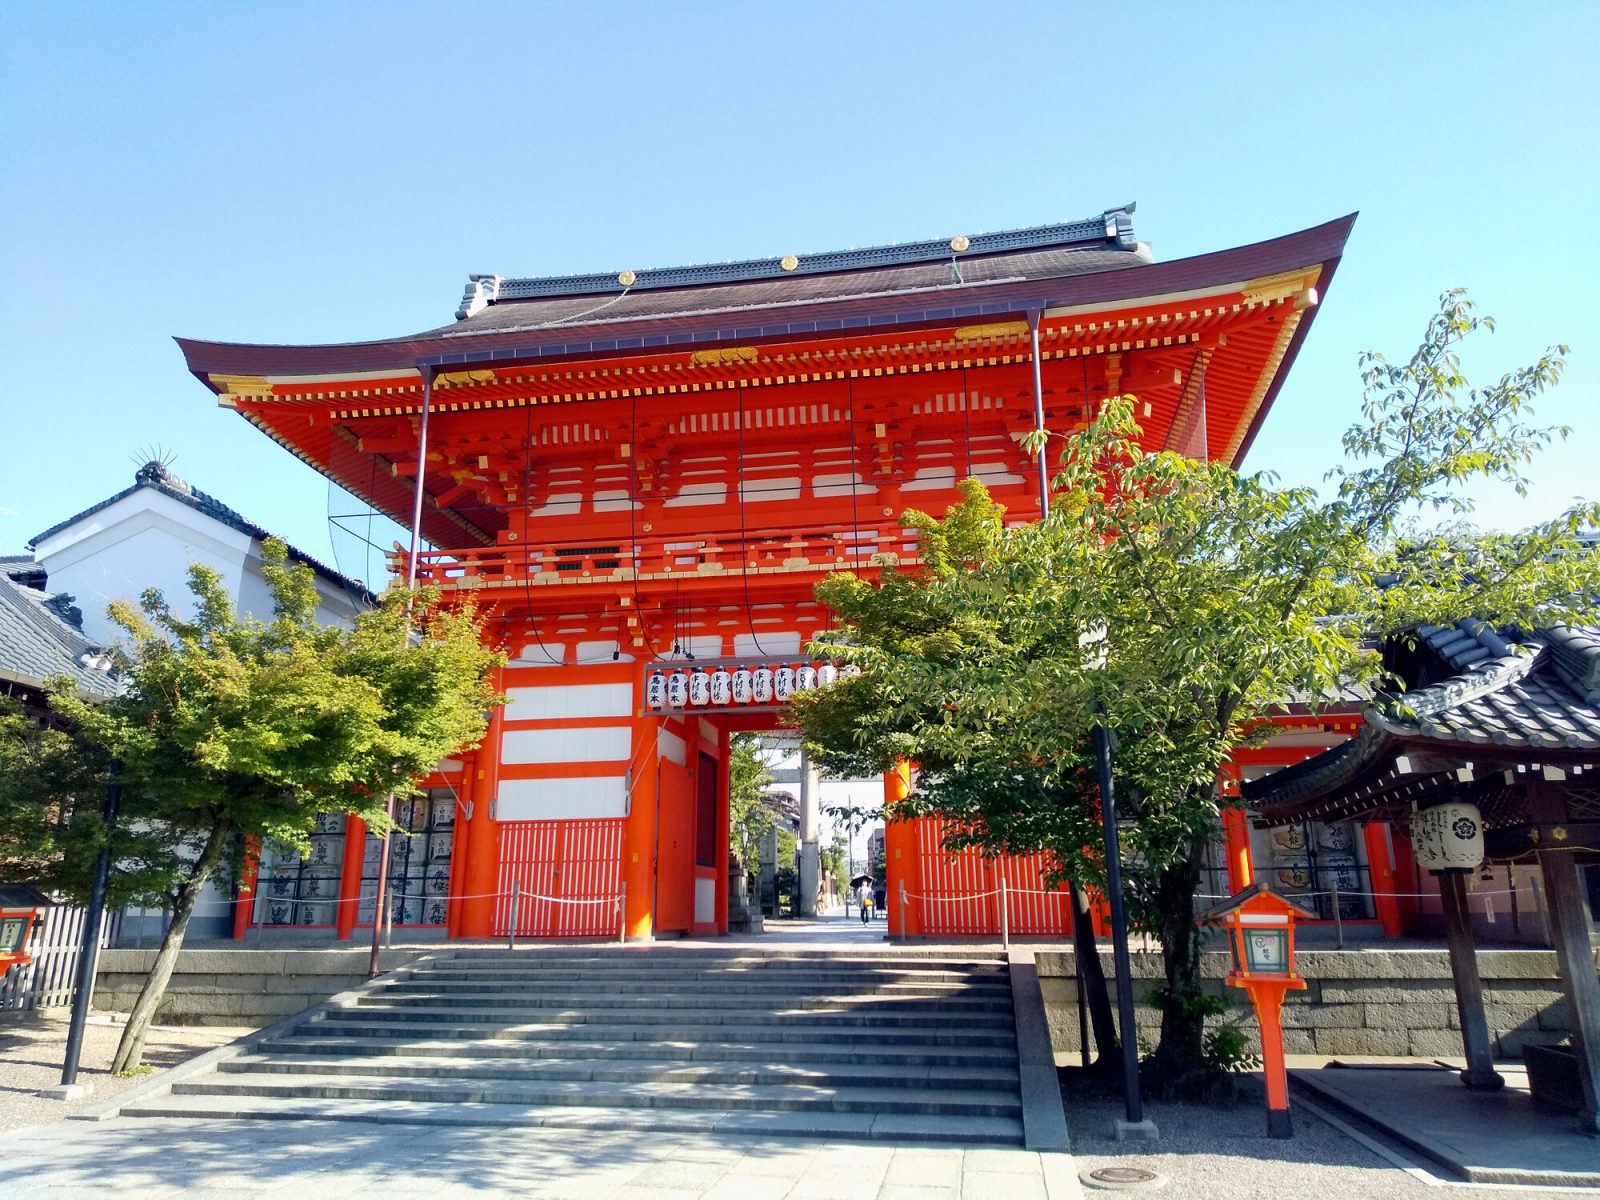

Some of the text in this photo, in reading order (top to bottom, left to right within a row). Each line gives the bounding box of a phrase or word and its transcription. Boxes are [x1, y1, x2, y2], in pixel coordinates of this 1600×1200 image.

[651, 675, 660, 703] 鳥居本
[670, 675, 680, 703] 鳥居本
